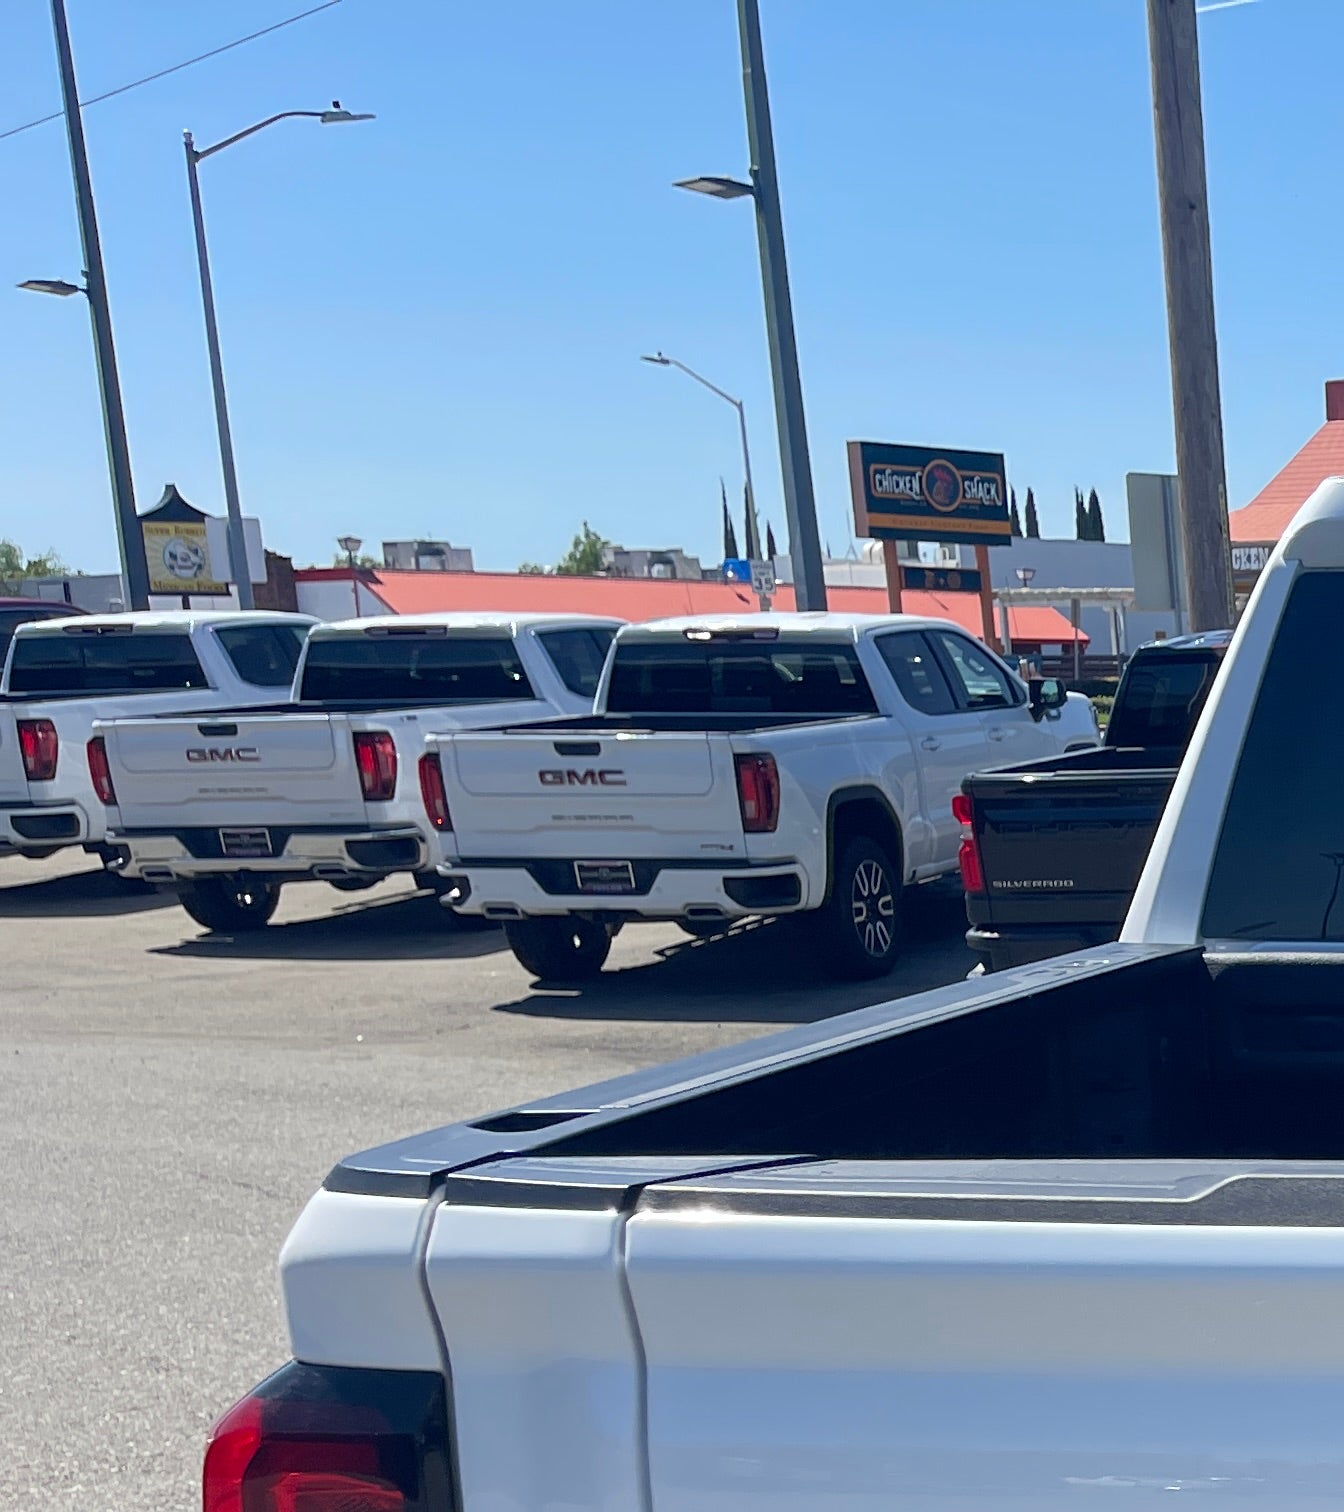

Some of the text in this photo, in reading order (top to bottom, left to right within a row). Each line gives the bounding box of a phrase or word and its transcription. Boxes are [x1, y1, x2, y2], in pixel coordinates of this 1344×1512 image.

[875, 469, 1003, 506] CHICKEN SHACK
[186, 747, 262, 763] GMC
[538, 769, 627, 786] GMC
[992, 879, 1074, 888] SILVERADO
